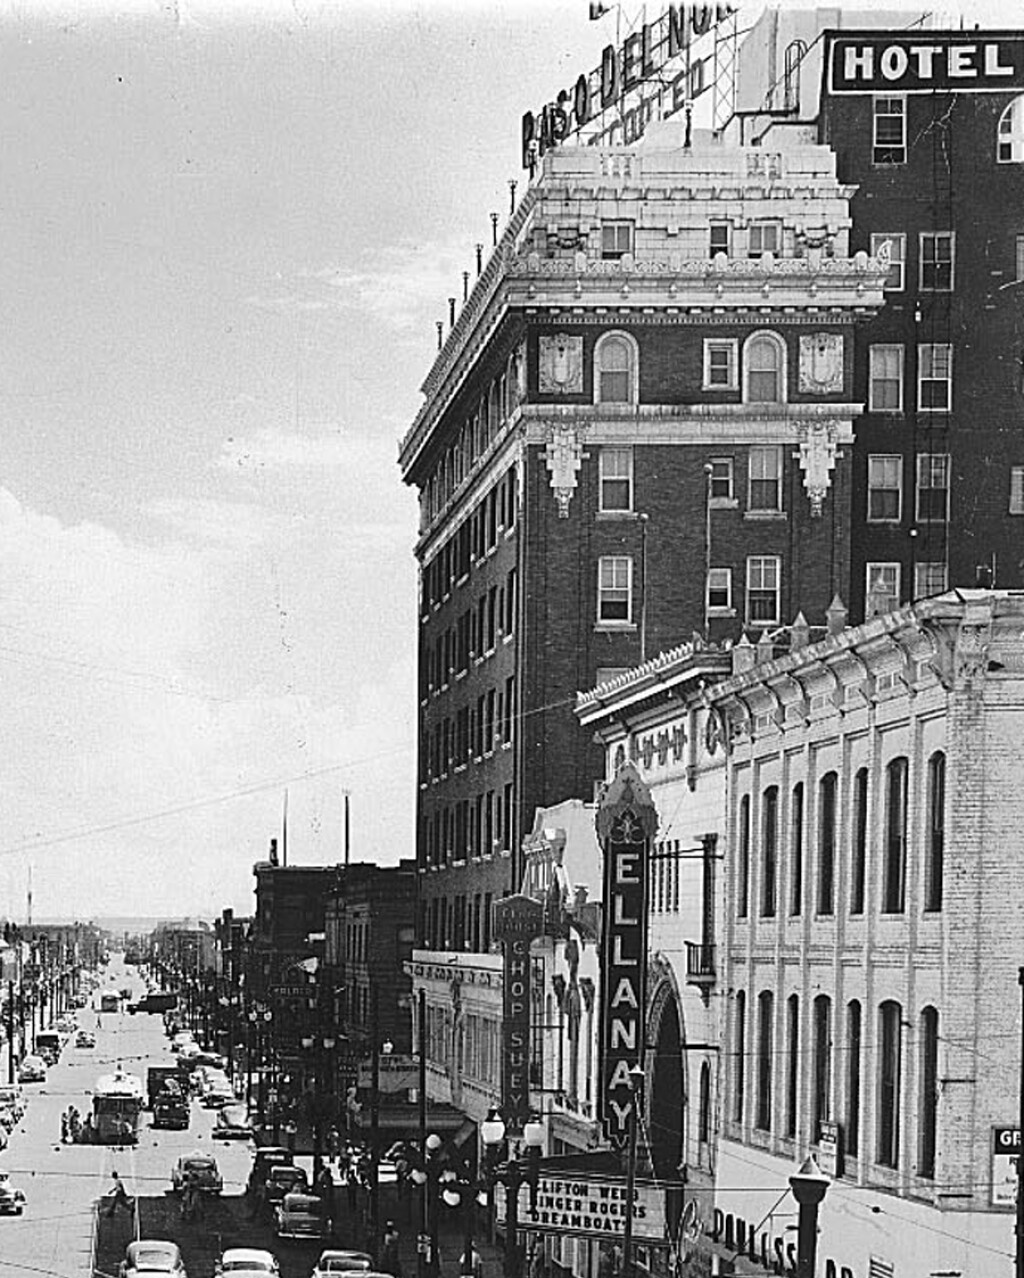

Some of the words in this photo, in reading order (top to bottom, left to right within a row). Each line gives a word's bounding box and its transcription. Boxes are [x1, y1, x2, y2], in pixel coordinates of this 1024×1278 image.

[601, 24, 654, 109] DEL
[844, 44, 1015, 80] HOTEL
[510, 940, 525, 1019] CHOP
[609, 852, 640, 1131] ELLANAY
[510, 1031, 525, 1109] SUEY
[538, 1181, 589, 1197] LIFTON
[538, 1196, 582, 1212] INGER
